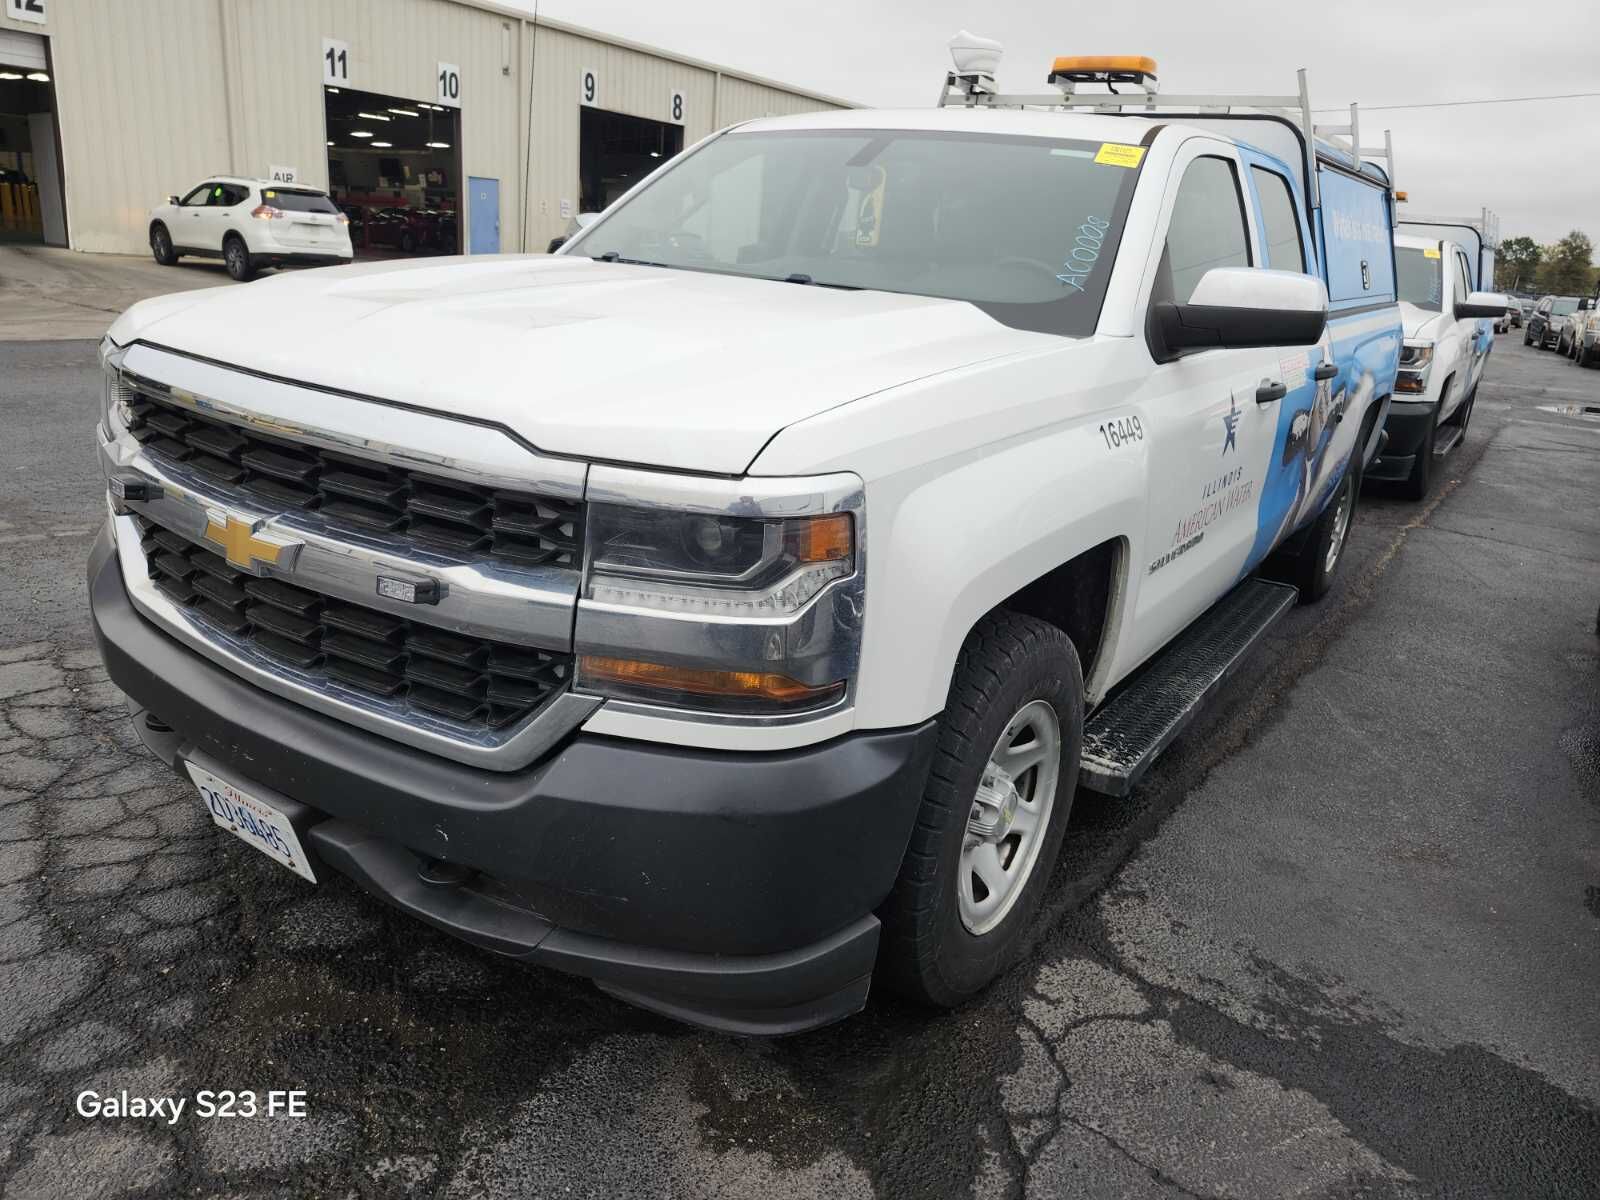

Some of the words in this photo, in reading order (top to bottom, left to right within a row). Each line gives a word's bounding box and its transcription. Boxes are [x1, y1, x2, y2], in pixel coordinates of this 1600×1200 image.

[326, 47, 347, 79] 11
[439, 70, 459, 99] 10
[585, 72, 595, 102] 9
[673, 93, 682, 121] 8
[273, 171, 294, 184] AIR
[1099, 415, 1144, 451] 16449
[1202, 466, 1243, 500] ILLINOIS
